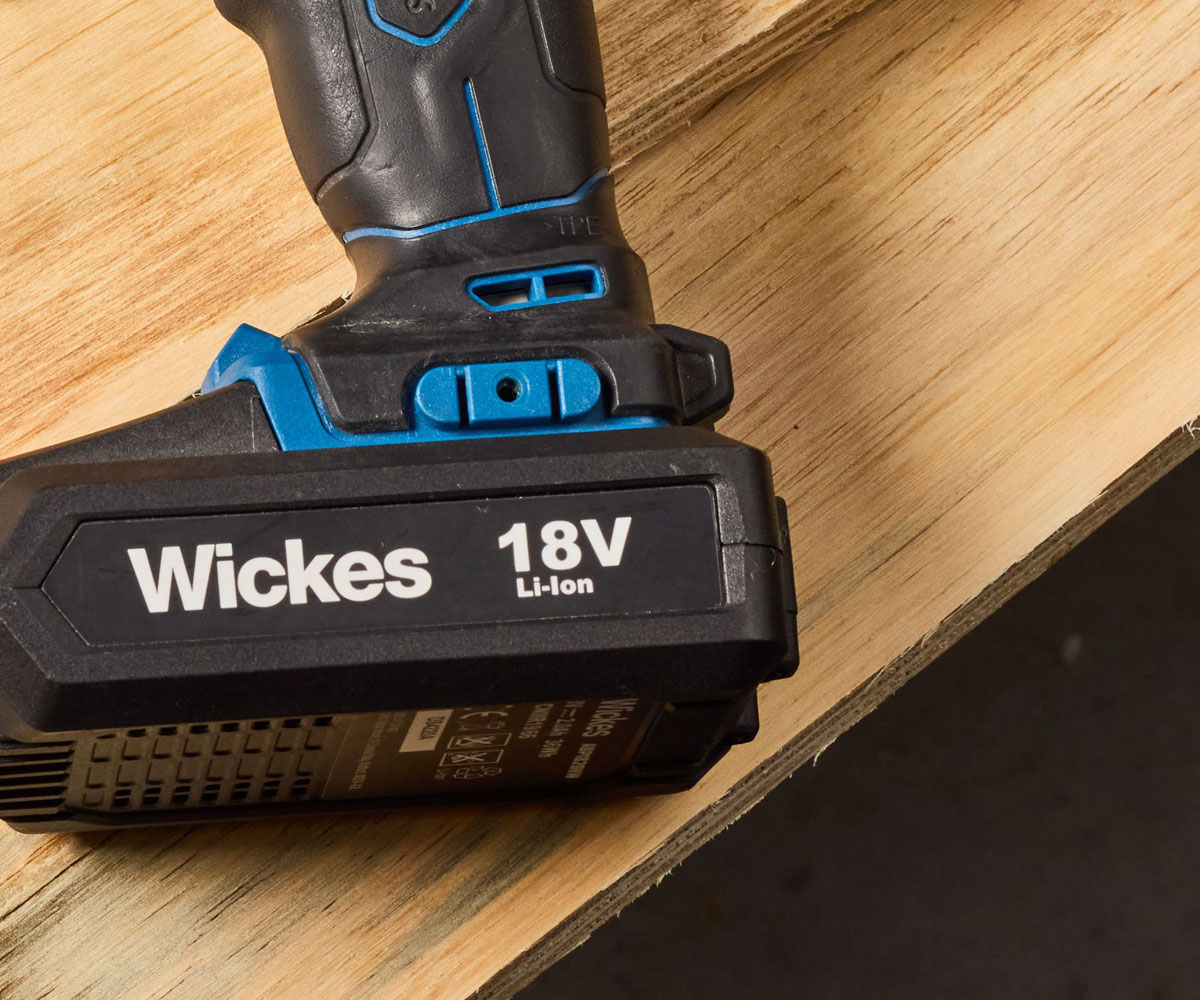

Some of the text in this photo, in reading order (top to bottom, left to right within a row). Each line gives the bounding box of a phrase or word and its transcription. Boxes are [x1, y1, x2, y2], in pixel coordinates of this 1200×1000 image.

[127, 516, 632, 613] Wickes 18V
[516, 574, 595, 599] Li-Ion
[581, 698, 639, 737] Wickes
